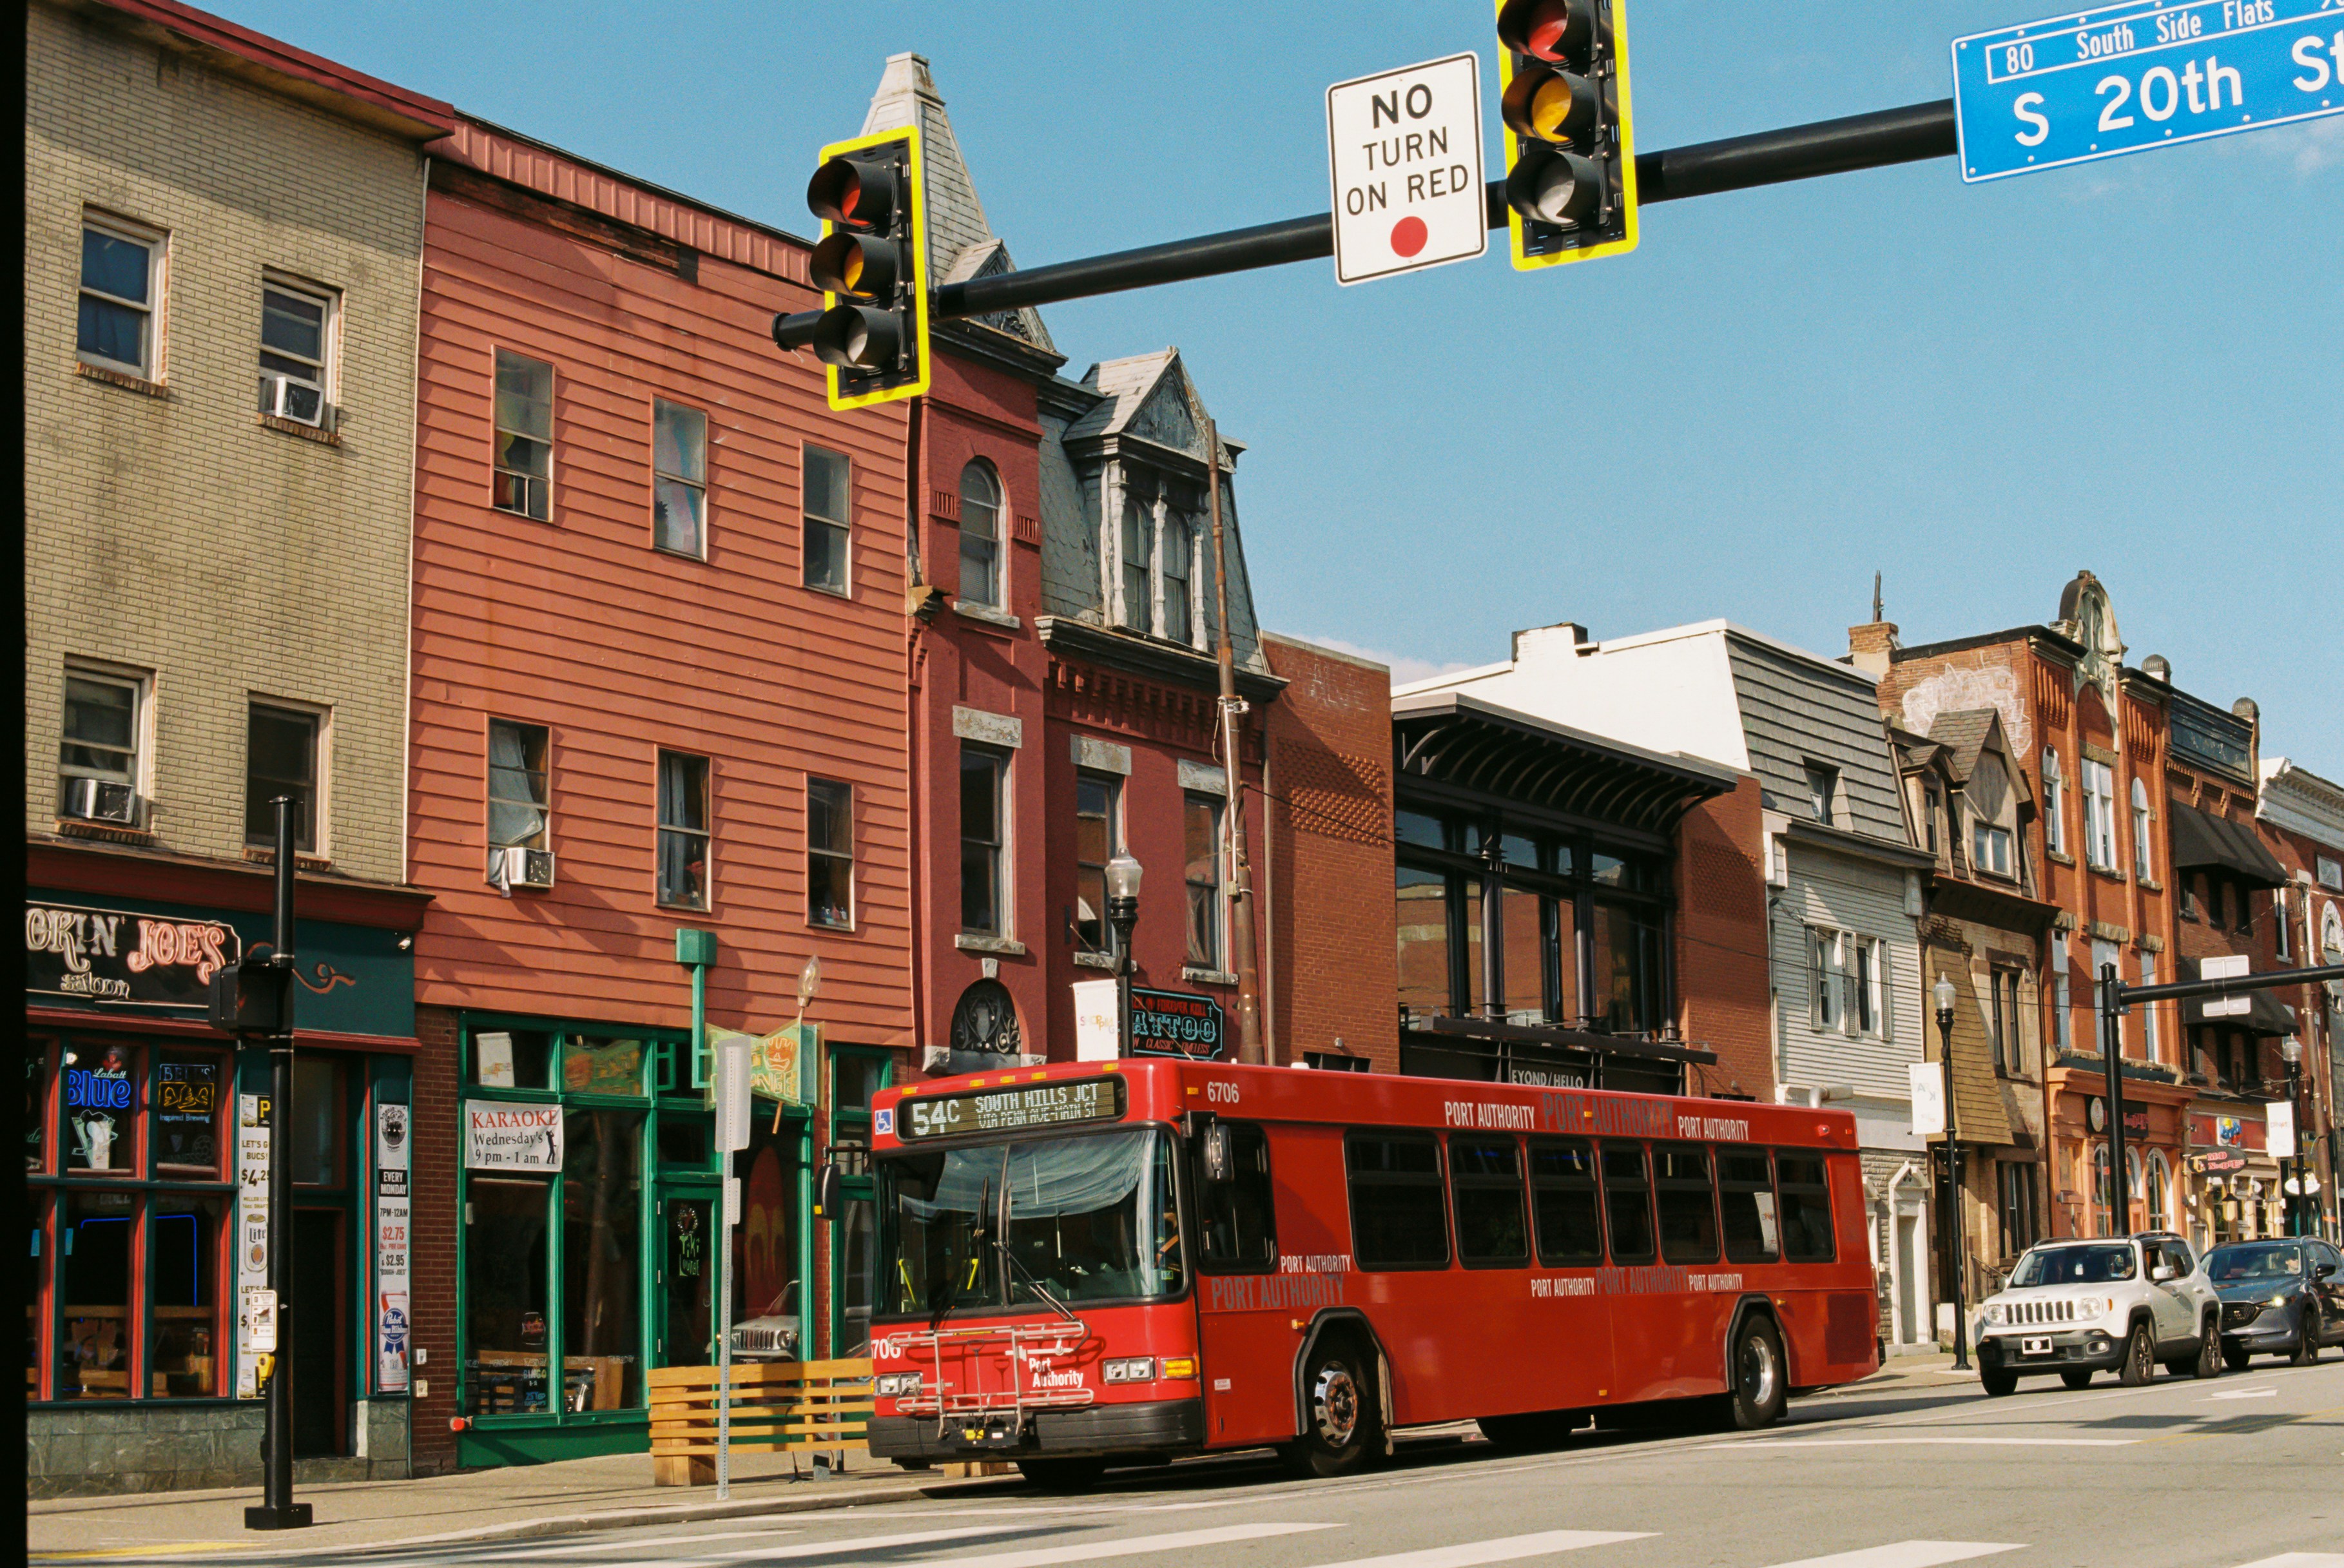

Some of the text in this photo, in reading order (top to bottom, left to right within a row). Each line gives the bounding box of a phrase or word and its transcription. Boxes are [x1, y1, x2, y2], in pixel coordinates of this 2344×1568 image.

[2006, 0, 2274, 74] 80 South Side Flats
[2013, 28, 2344, 147] S 20th St
[1371, 83, 1432, 129] NO
[1362, 126, 1448, 171] TURN
[1346, 164, 1469, 215] ON RED
[26, 907, 225, 987] OKIN' JOE'S
[1132, 1010, 1217, 1043] ATTOO
[1146, 1038, 1174, 1050] CLASSIC
[92, 1067, 127, 1079] Labatt
[163, 1067, 212, 1081] BEL'S
[1512, 1069, 1584, 1089] EYOND/HELLO
[67, 1069, 131, 1108] Blue
[710, 1070, 799, 1103] LNGE
[1206, 1081, 1240, 1104] 6706
[472, 1110, 557, 1128] KARAOKE
[913, 1083, 1098, 1136] 54C SOUTH HILLS JCT
[978, 1114, 998, 1128] VIA
[1001, 1109, 1027, 1127] PENN
[1084, 1102, 1097, 1118] ST
[1444, 1101, 1535, 1129] PORT AUTHORITY
[1542, 1092, 1674, 1136] PORT AUTHORITY
[1678, 1116, 1748, 1141] PORT AUTHORITY
[242, 1140, 269, 1149] LET'S G
[474, 1131, 543, 1148] Wednesday's
[246, 1152, 268, 1161] BUCS!
[475, 1148, 481, 1161] 9
[485, 1152, 501, 1165] pm
[514, 1152, 519, 1163] 1
[383, 1172, 403, 1183] EVERY
[381, 1184, 407, 1195] MONDAY
[380, 1208, 408, 1217] 7PM-12AM
[249, 1227, 266, 1243] Lite
[382, 1226, 405, 1241] $2.75
[386, 1254, 405, 1266] $2.95
[1281, 1255, 1350, 1273] PORT AUTHORITY
[1531, 1277, 1594, 1297] PORT AUTHORITY
[1596, 1266, 1687, 1295] PORT AUTHORITY
[1688, 1273, 1743, 1292] PORT AUTHORITY
[1211, 1273, 1344, 1310] PORT AUTHORITY
[385, 1312, 402, 1324] Pabst
[871, 1339, 902, 1359] 706
[523, 1368, 547, 1379] BINGO
[1029, 1357, 1051, 1372] Port
[1032, 1370, 1083, 1388] Authority
